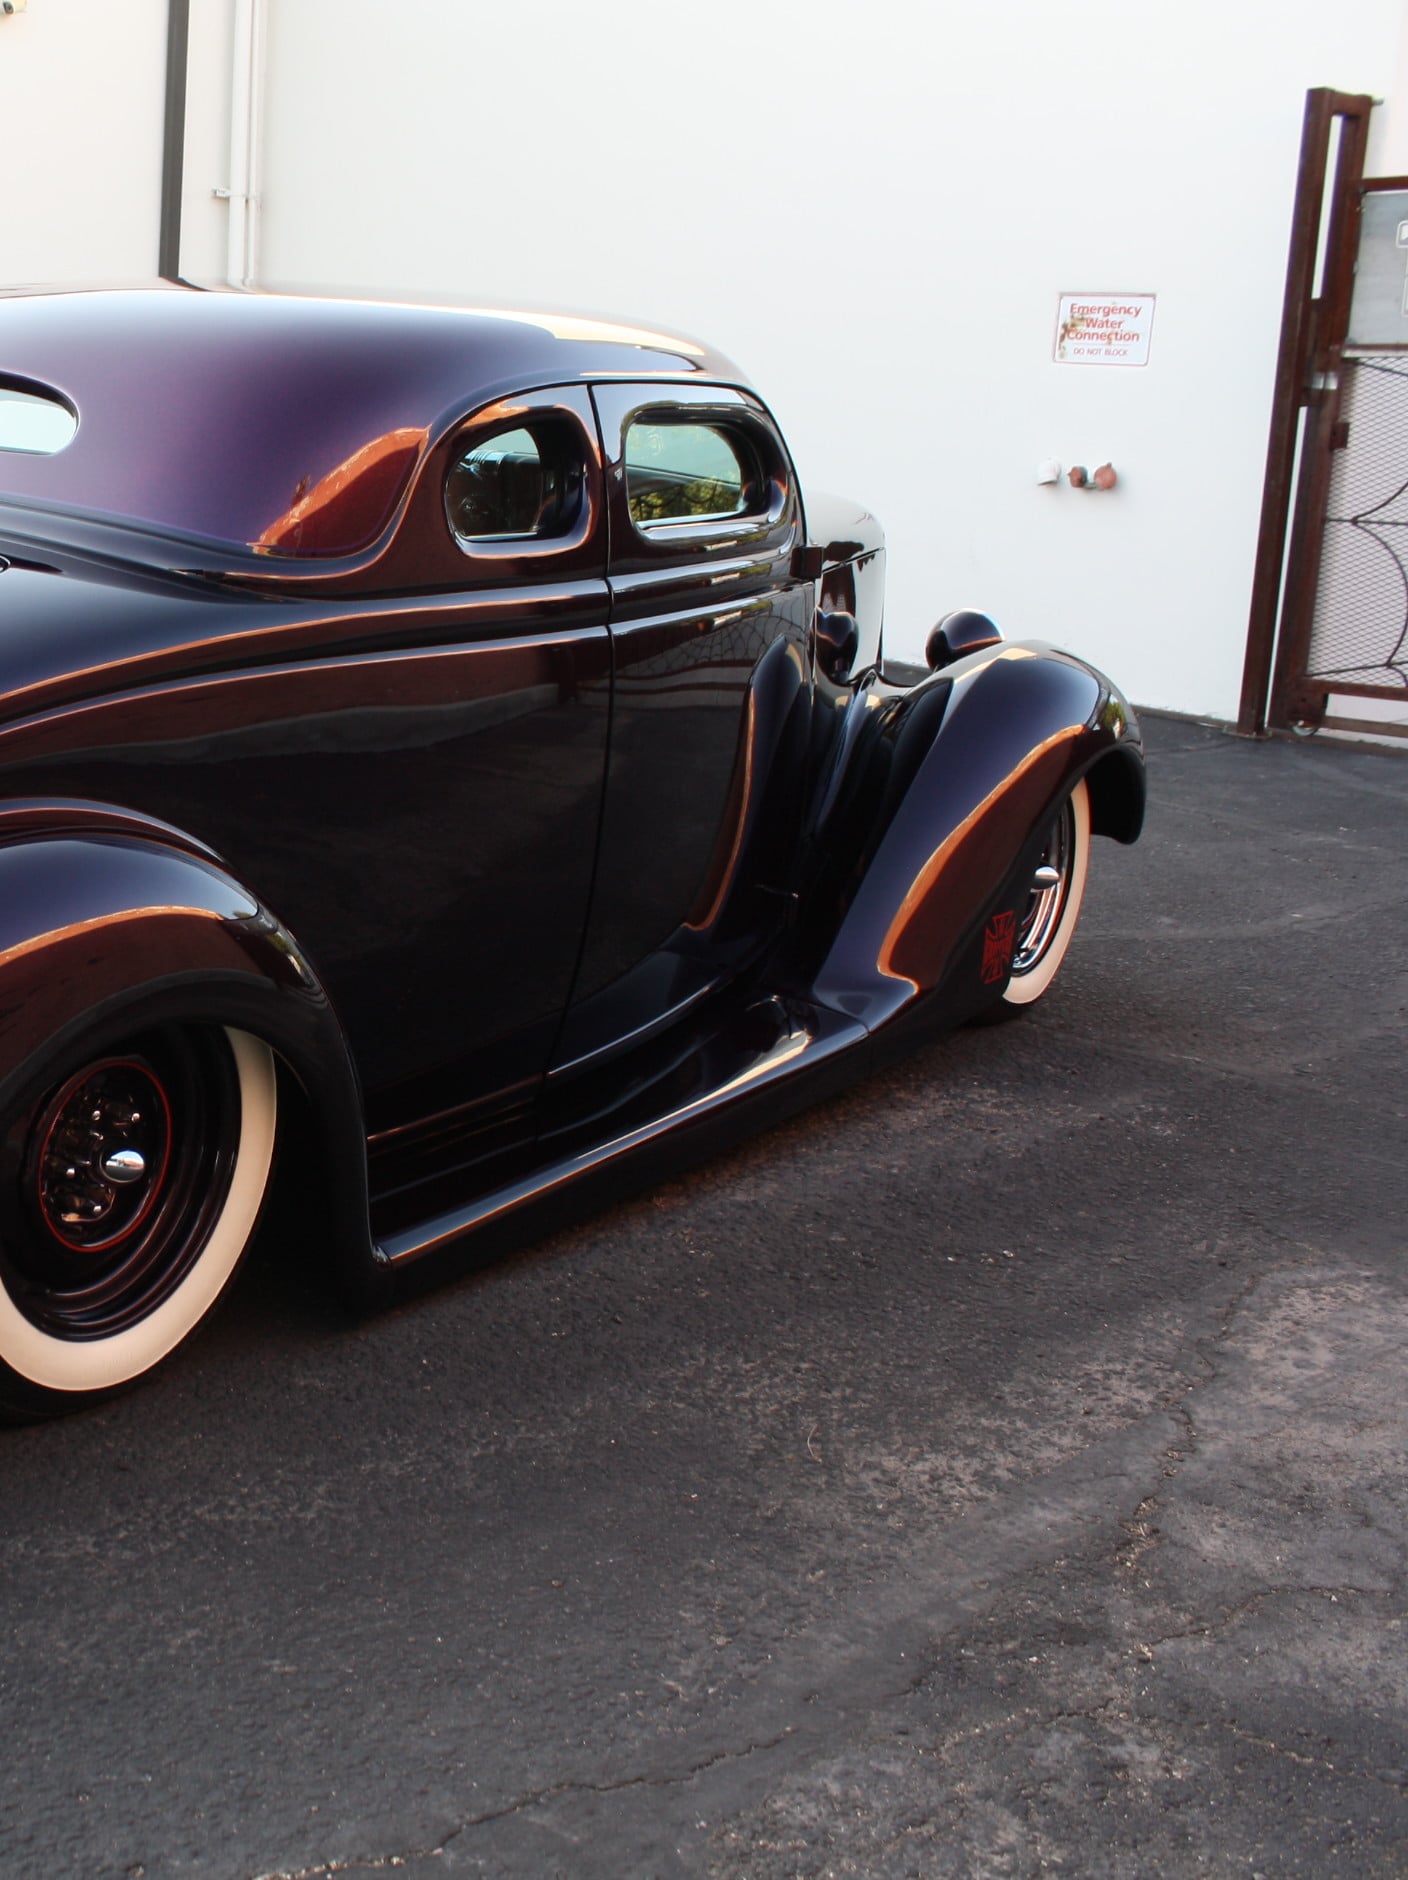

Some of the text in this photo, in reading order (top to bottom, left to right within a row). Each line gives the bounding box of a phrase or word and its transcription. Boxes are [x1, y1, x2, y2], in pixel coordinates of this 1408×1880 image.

[1070, 303, 1141, 317] Emergency
[1085, 318, 1124, 328] Water
[1068, 330, 1139, 341] Connection
[1073, 347, 1129, 356] DO NOT BLOCK
